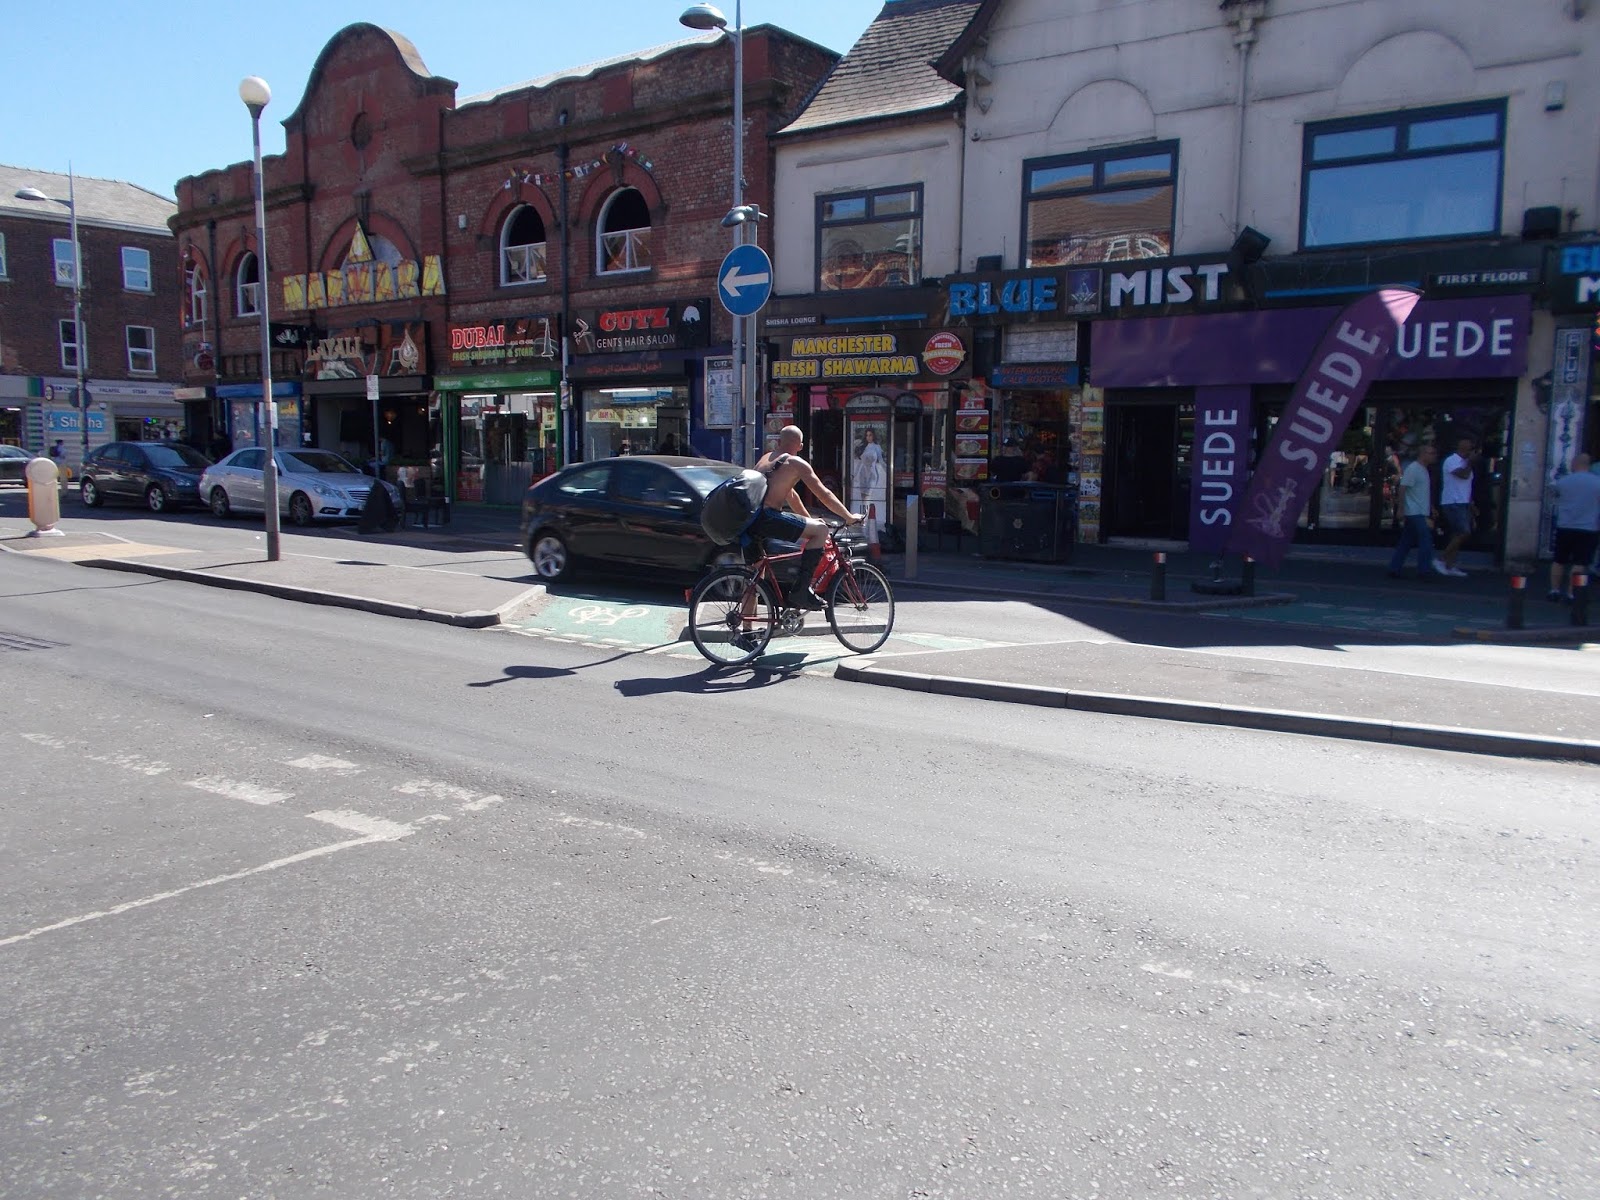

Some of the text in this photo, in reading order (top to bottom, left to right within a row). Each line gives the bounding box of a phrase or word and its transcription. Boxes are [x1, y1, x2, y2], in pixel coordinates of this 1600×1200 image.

[1437, 271, 1528, 284] FIRST FLOOR
[949, 264, 1229, 317] BLUE MIST
[599, 307, 670, 332] CUTZ
[766, 316, 817, 326] SHISHA LOUNGE
[305, 336, 361, 361] LAYALI
[452, 325, 505, 349] DUBAI
[596, 333, 675, 349] GENTS HAIR SALON
[792, 334, 896, 356] MANCHESTER
[1385, 319, 1513, 359] UEDE
[772, 360, 819, 378] FRESH
[822, 356, 918, 377] SHAWARMA
[1280, 321, 1381, 471] SUEDE
[60, 416, 103, 429] Shiha
[1200, 410, 1237, 525] SUEDE
